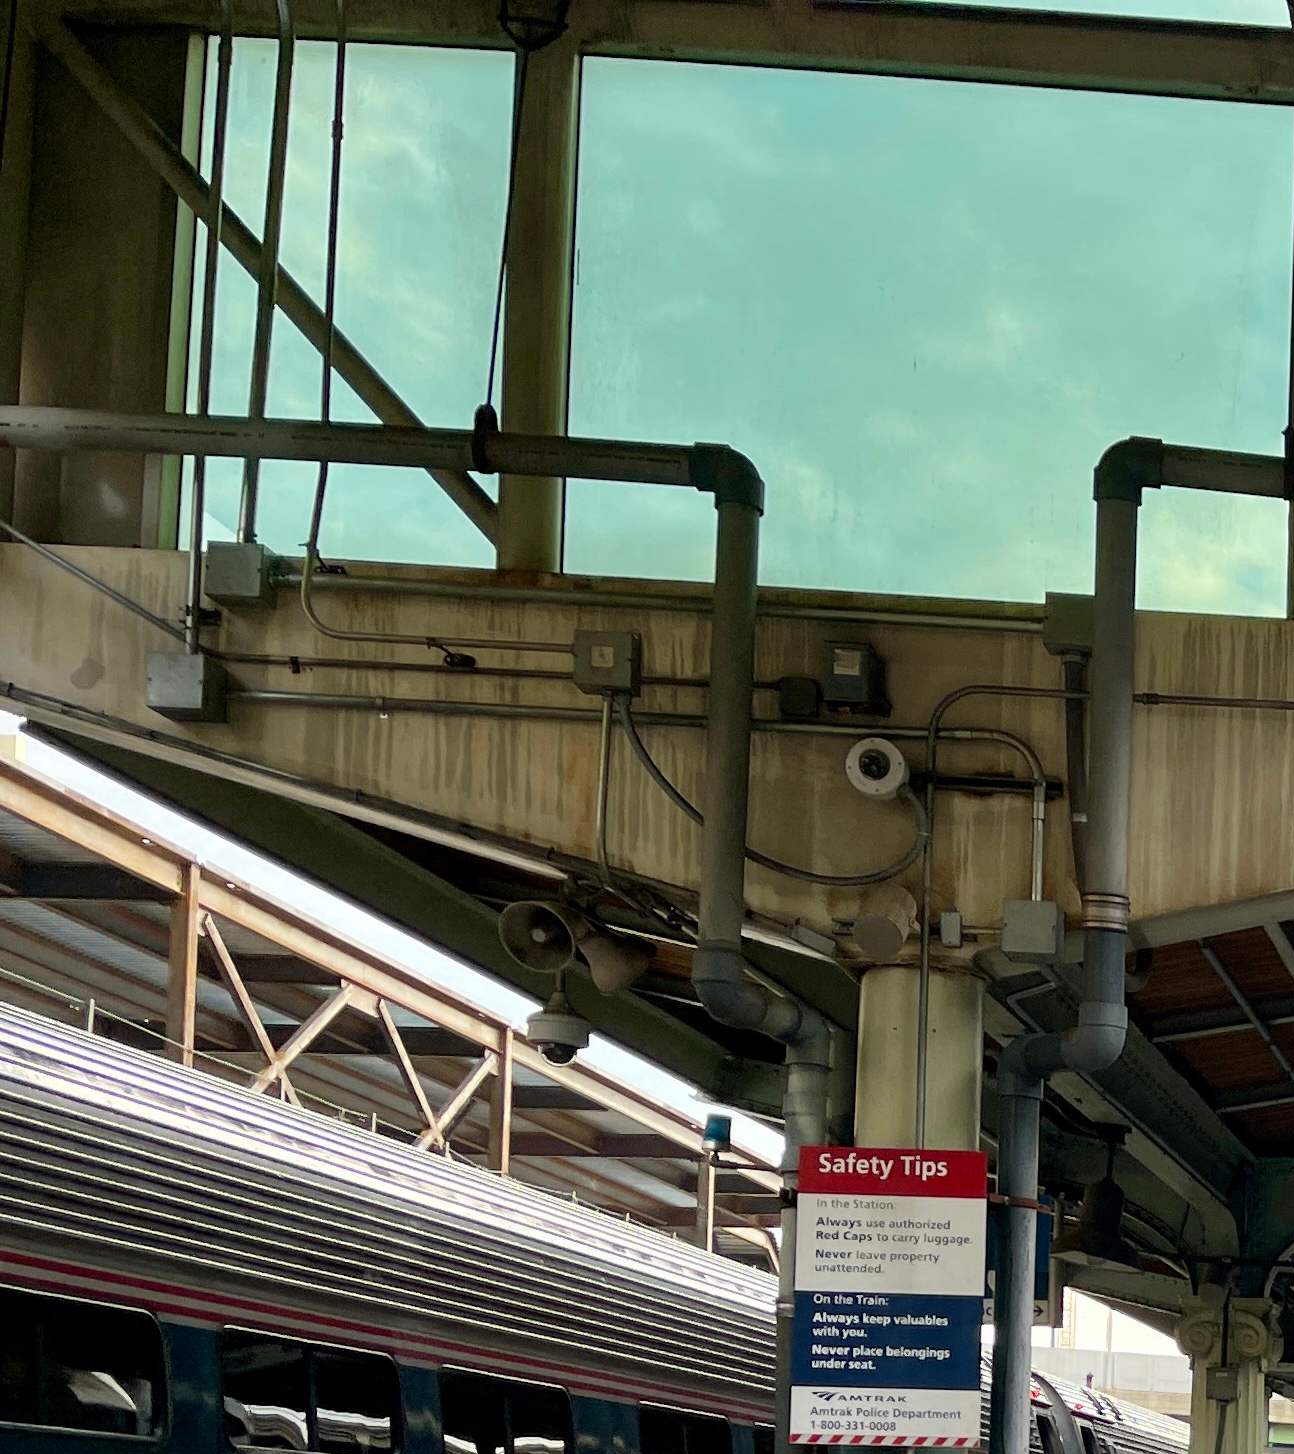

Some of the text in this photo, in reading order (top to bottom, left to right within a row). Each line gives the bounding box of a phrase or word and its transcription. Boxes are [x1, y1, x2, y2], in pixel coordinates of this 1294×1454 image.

[818, 1153, 948, 1181] Safety Tips
[816, 1199, 896, 1210] In the Station:
[816, 1217, 951, 1230] Always use authorized
[816, 1231, 973, 1246] Red Caps to carry luggage.
[815, 1249, 940, 1263] Never leave property
[815, 1263, 885, 1274] unattended.
[812, 1293, 889, 1306] On the Train:
[812, 1312, 949, 1327] Always keep valuables
[812, 1327, 868, 1340] with you.
[812, 1344, 950, 1360] Never place belongings
[811, 1359, 876, 1370] under seat.
[838, 1394, 907, 1403] AMTRAK
[810, 1406, 961, 1420] Amtrak Police Department
[810, 1420, 897, 1431] 1-800-331-0008
